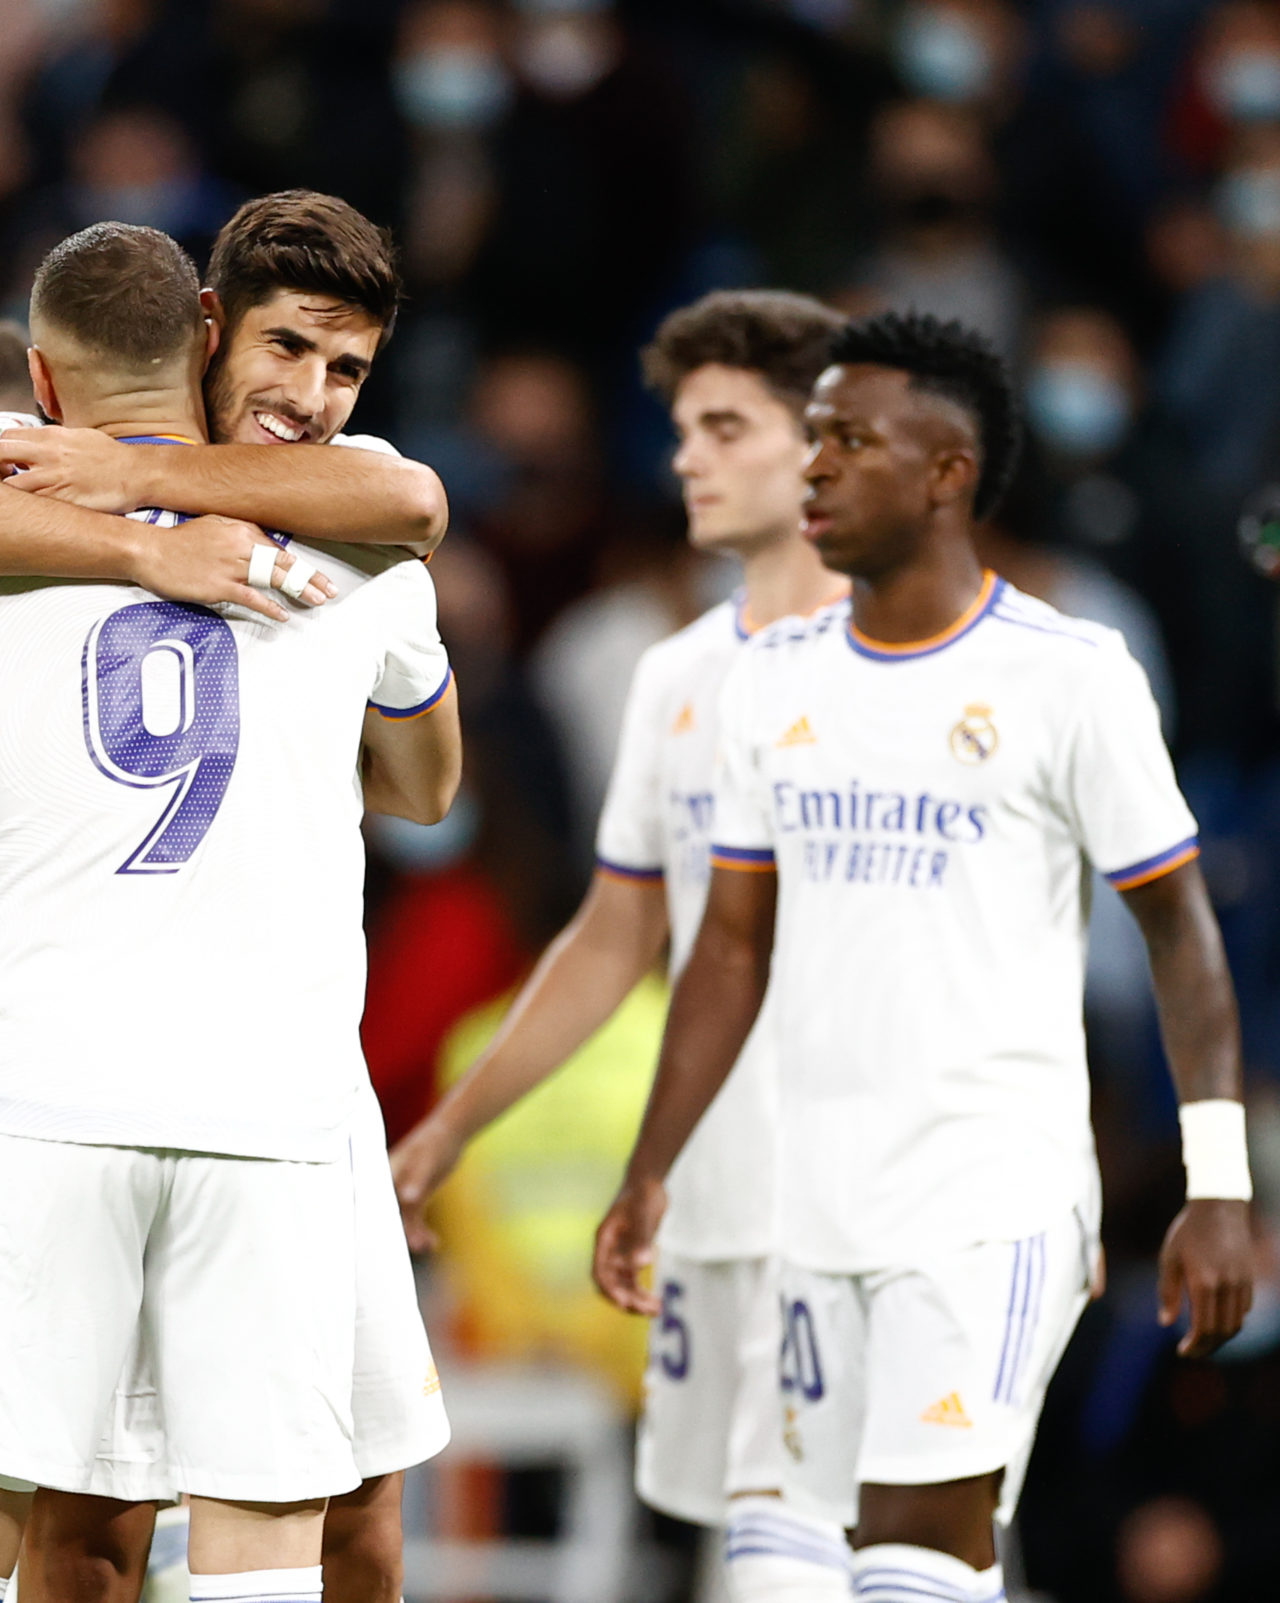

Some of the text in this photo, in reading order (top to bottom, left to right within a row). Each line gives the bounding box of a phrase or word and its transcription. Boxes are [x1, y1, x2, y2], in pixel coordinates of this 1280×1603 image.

[81, 600, 241, 876] 9
[773, 780, 986, 843] Emirates
[845, 842, 950, 888] BETTER
[653, 1281, 691, 1382] 5
